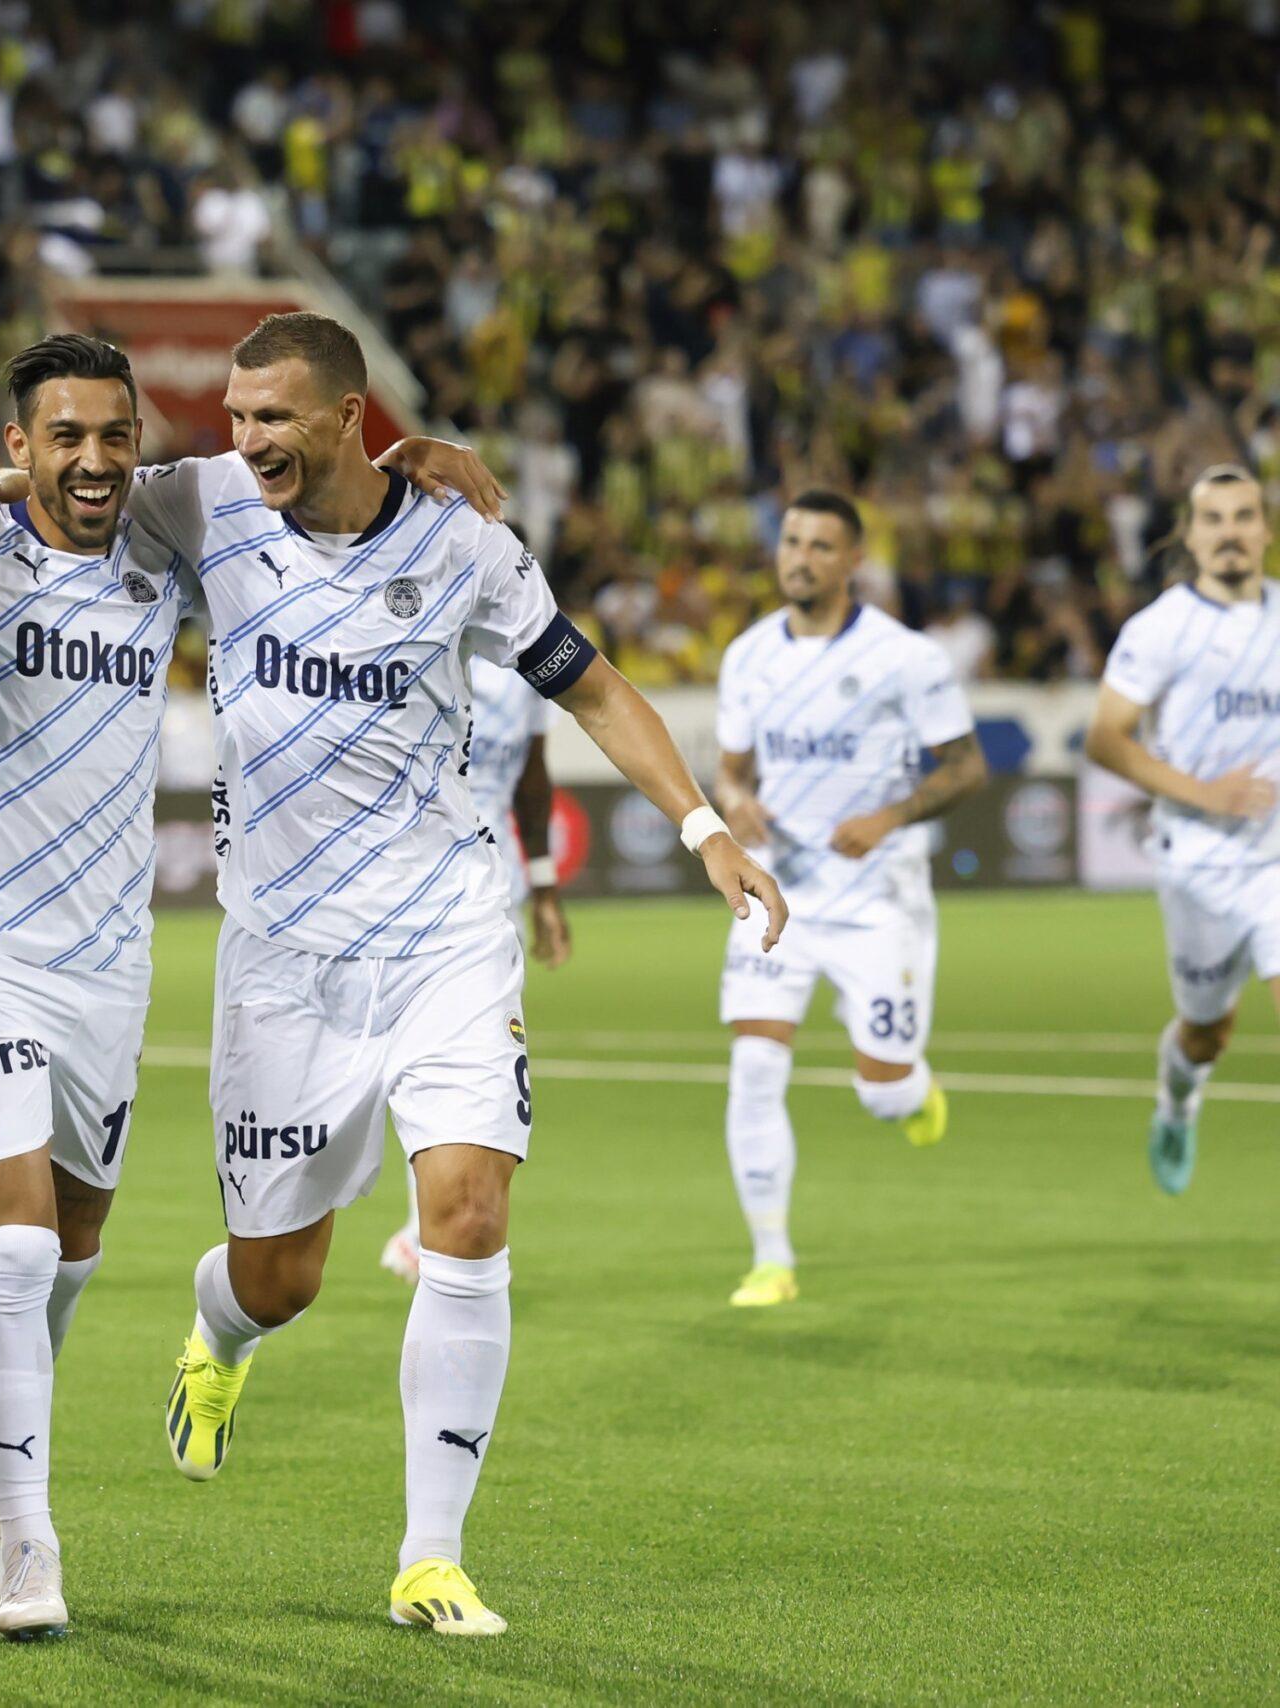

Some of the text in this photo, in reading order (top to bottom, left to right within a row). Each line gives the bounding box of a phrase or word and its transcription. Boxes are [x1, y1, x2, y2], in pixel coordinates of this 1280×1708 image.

[16, 621, 155, 697] Otokoç
[255, 633, 409, 709] Otokoç
[538, 637, 578, 680] RESPECT
[870, 997, 917, 1042] 33
[513, 1053, 532, 1127] 9
[102, 1100, 135, 1166] 1
[225, 1110, 328, 1163] pürsu
